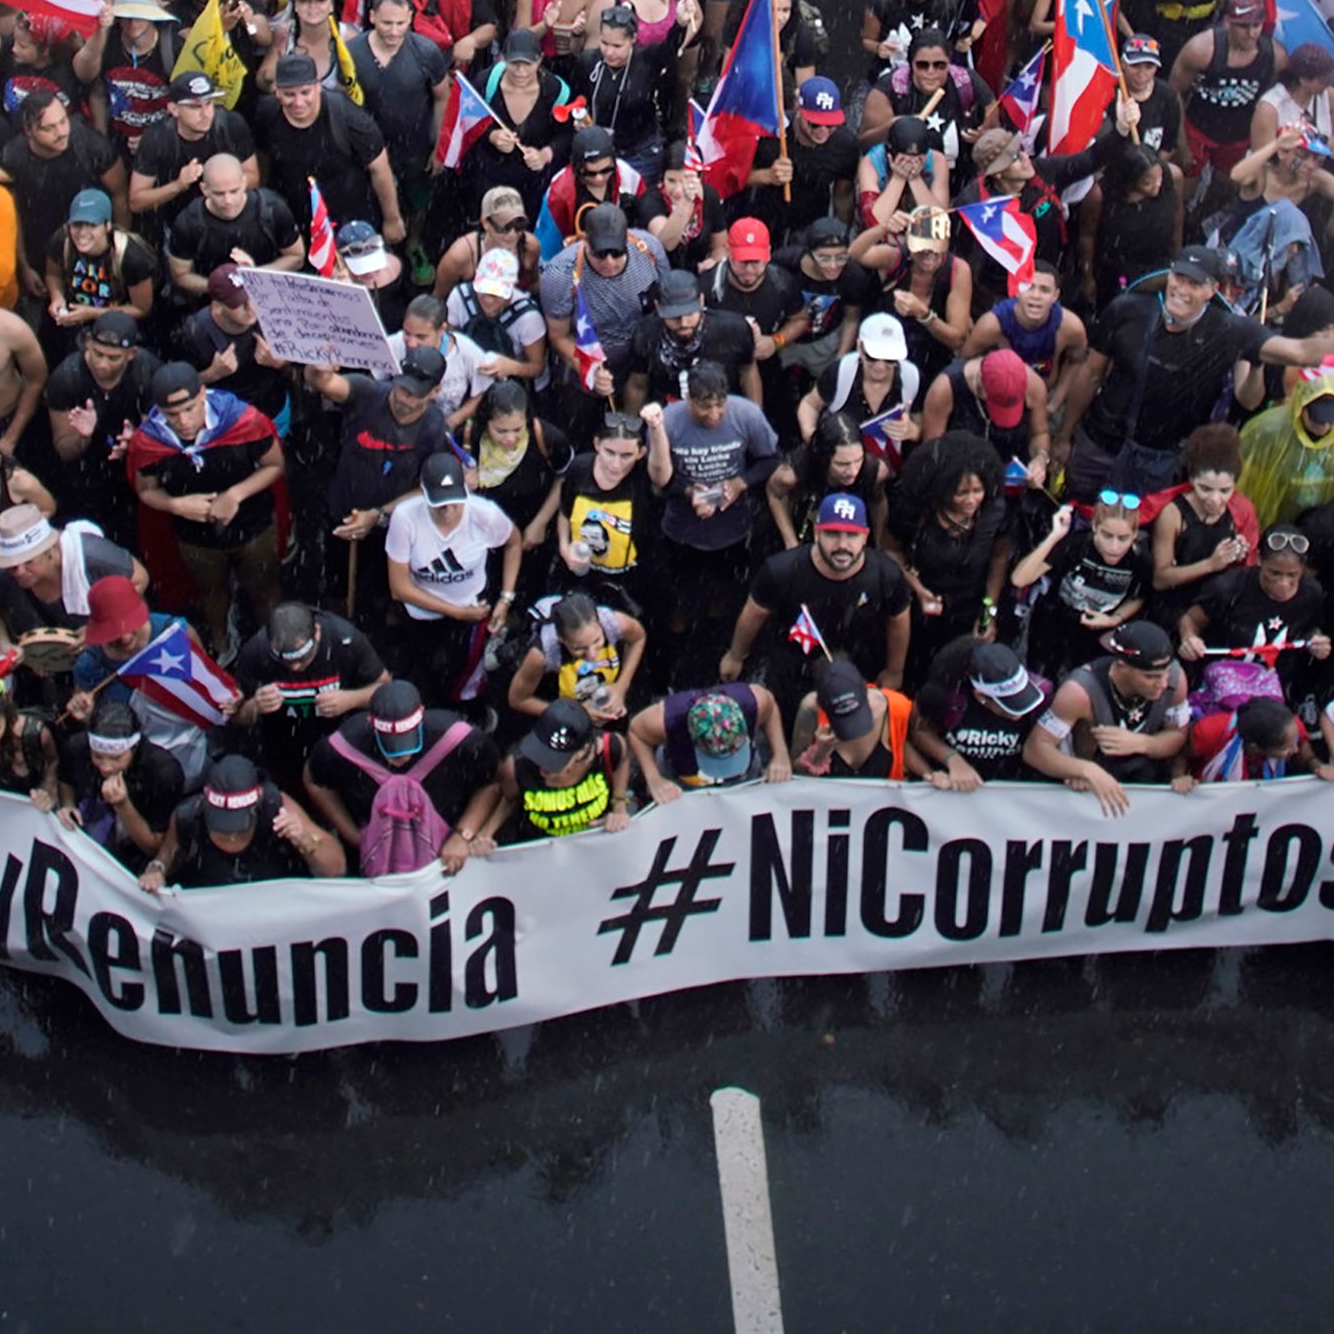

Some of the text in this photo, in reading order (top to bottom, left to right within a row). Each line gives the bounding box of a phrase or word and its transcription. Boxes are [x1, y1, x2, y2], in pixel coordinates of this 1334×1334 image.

[73, 260, 107, 280] ALL
[71, 276, 110, 298] FOR
[956, 729, 1019, 751] #Ricky
[523, 787, 576, 813] SOMOS
